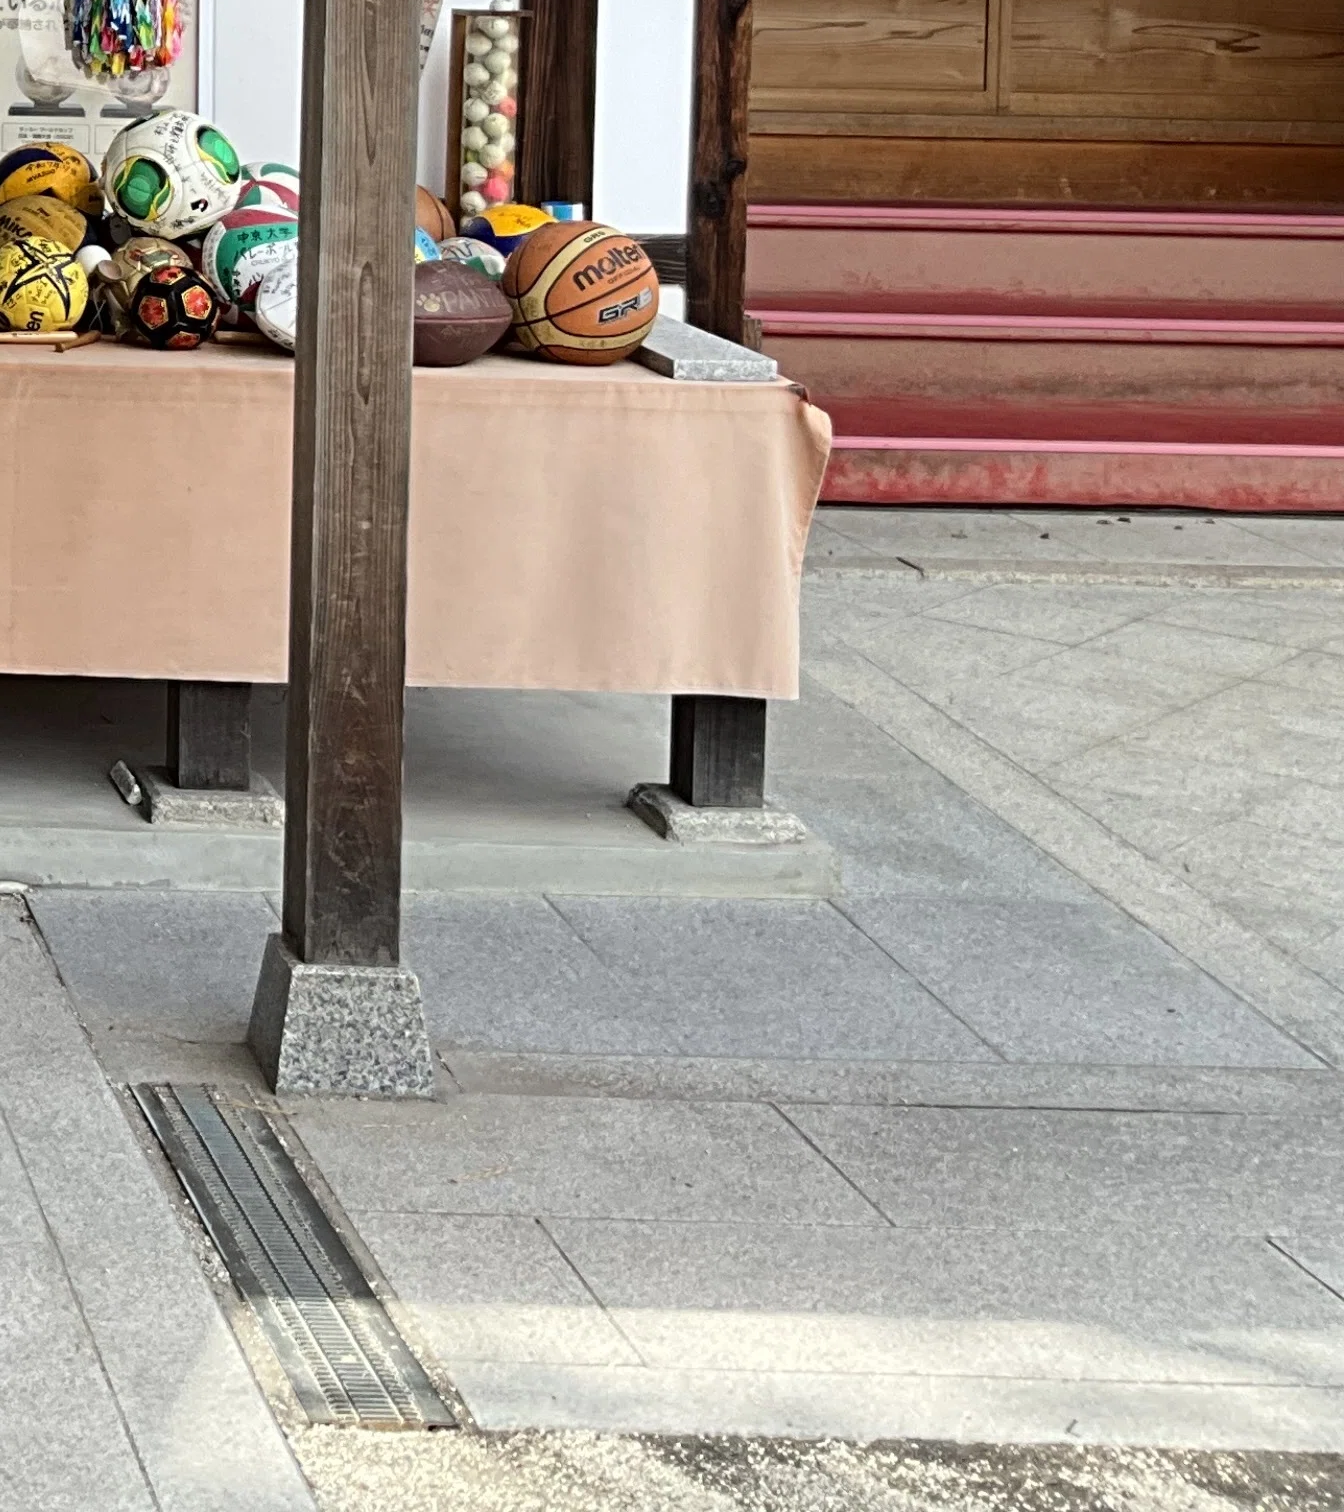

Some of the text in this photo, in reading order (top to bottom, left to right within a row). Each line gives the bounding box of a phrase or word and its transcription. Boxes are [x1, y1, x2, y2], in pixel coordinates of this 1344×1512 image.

[233, 241, 298, 261] バレーボール
